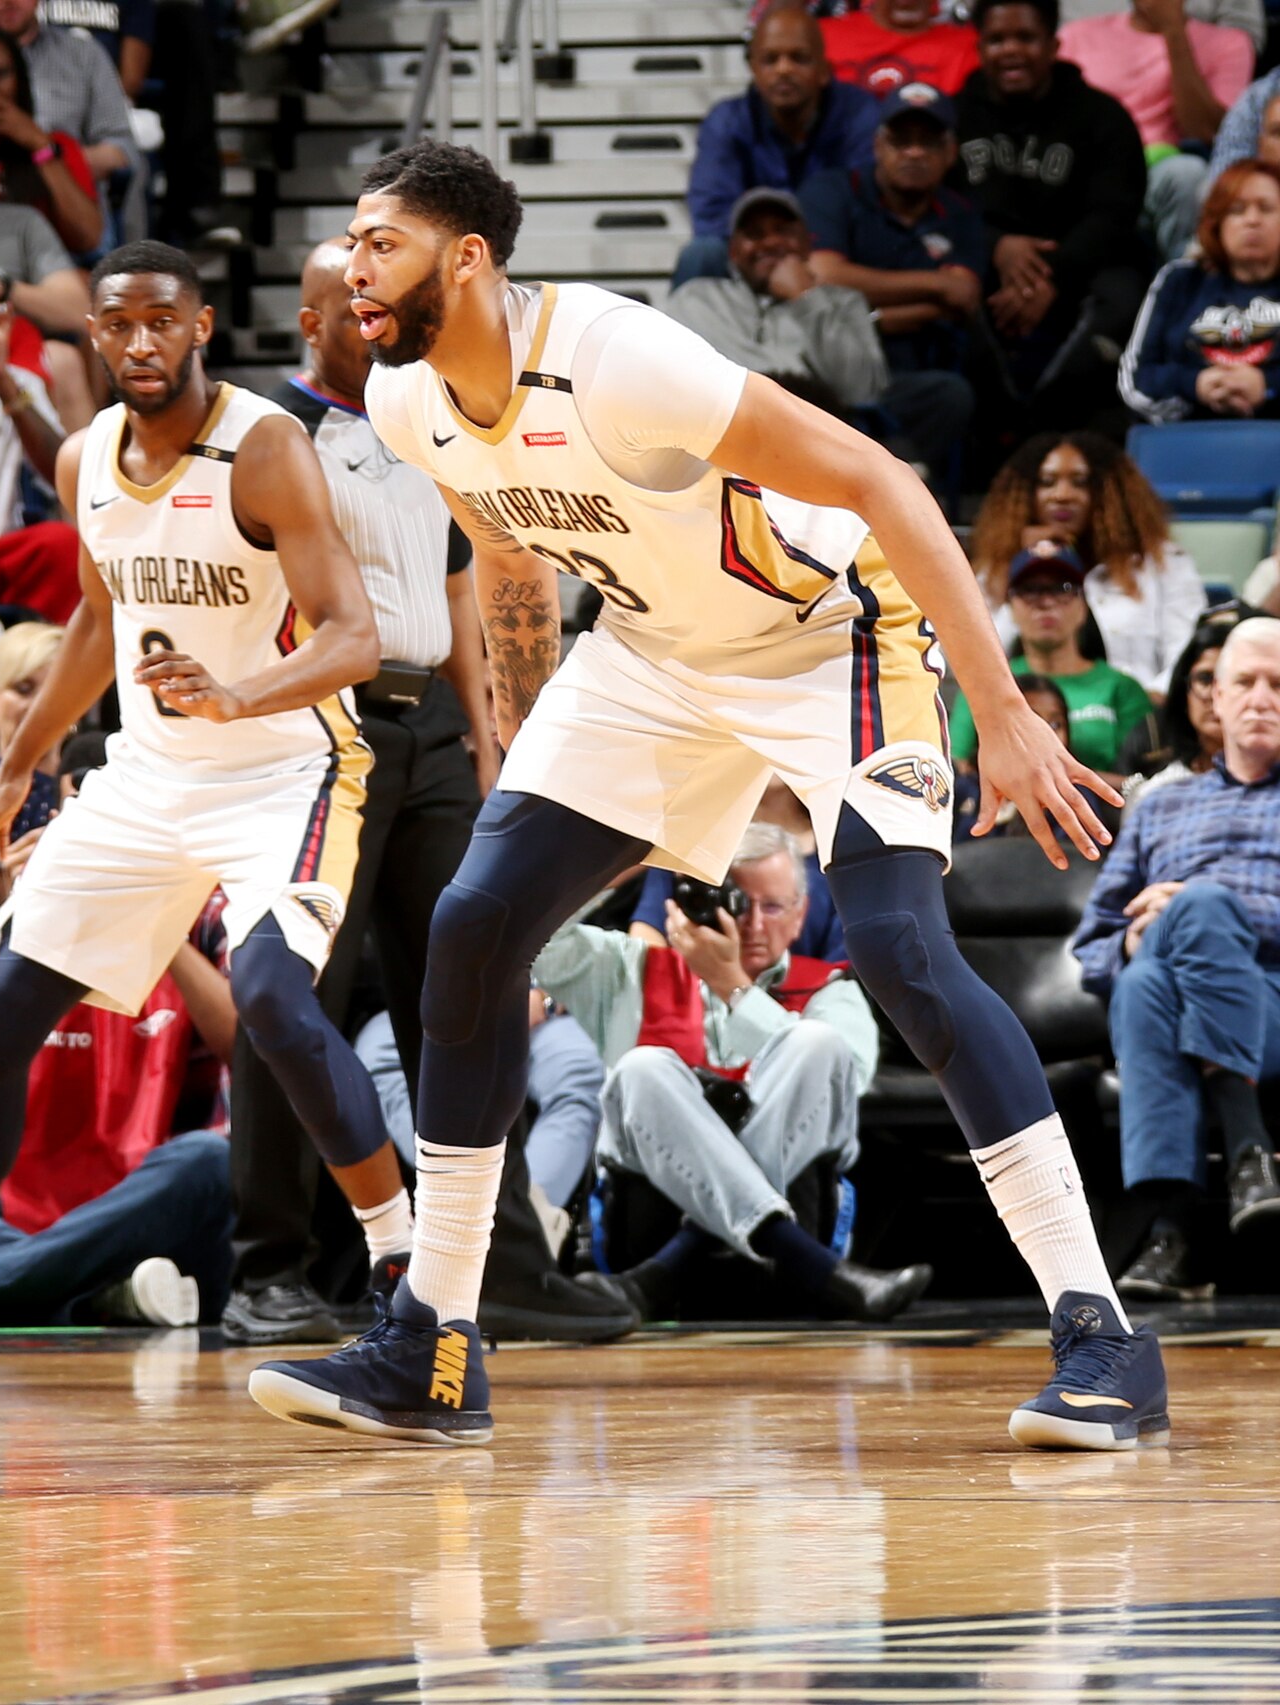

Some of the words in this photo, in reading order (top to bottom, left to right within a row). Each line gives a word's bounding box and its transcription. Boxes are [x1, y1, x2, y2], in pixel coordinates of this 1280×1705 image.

[961, 133, 1074, 184] POLO
[496, 486, 630, 534] ORLEANS
[132, 556, 249, 607] ORLEANS
[429, 1325, 469, 1410] NIKE
